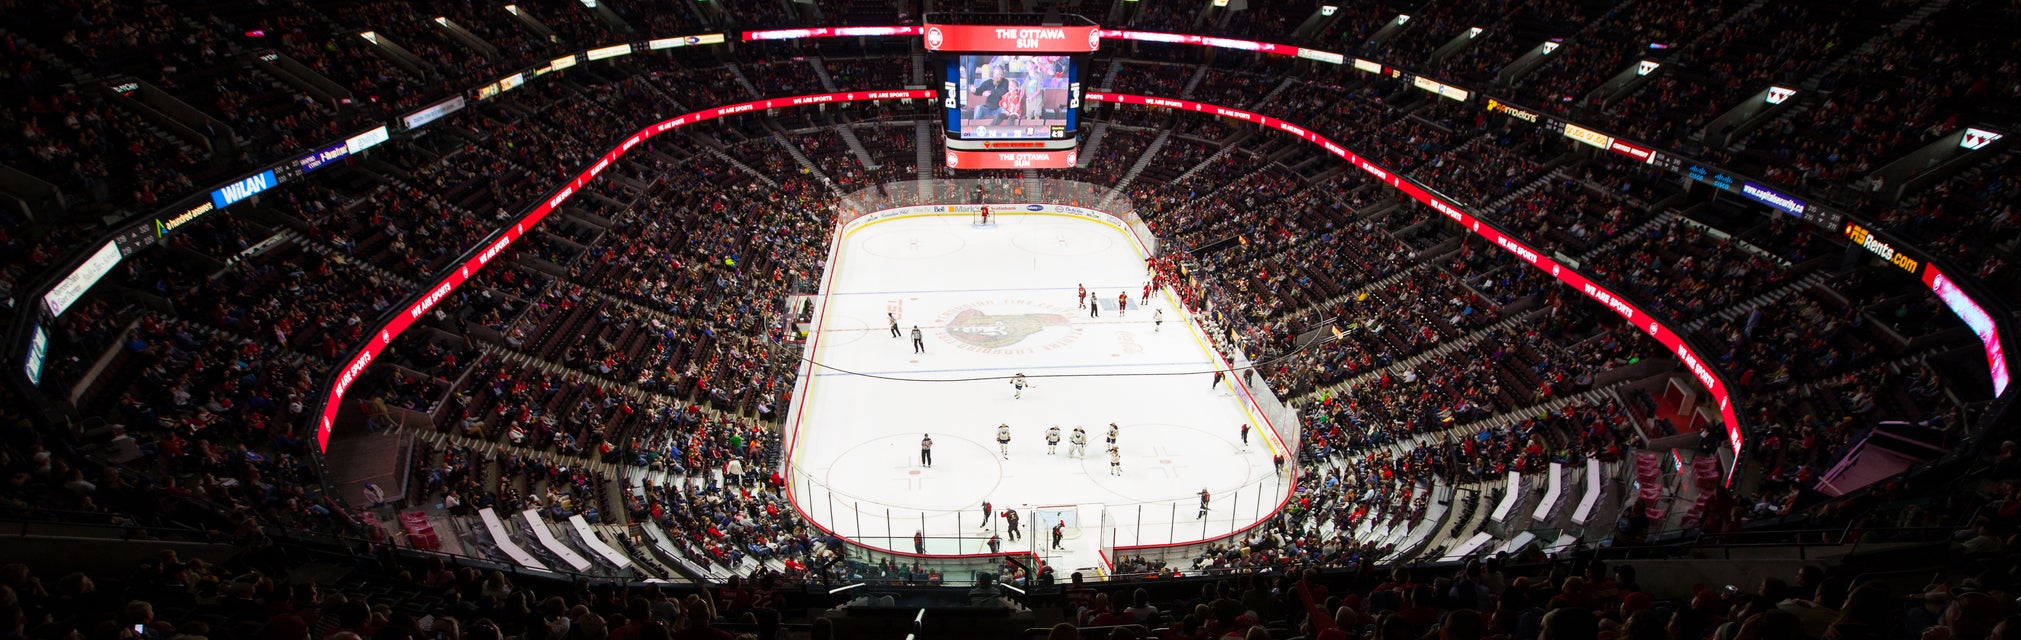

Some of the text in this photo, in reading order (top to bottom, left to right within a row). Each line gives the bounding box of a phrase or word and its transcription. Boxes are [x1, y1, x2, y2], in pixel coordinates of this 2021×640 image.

[995, 29, 1066, 40] THE OTTAWA
[1016, 39, 1039, 49] SUN
[944, 81, 957, 109] Bell
[1070, 82, 1080, 109] Bell
[1164, 100, 1182, 108] SPORTS
[725, 106, 735, 114] ARE
[735, 104, 753, 112] SPORTS
[220, 173, 267, 205] WiLAN
[1689, 171, 1703, 181] CISCO
[1713, 180, 1729, 190] CISCO
[1431, 199, 1438, 208] WE
[1446, 207, 1462, 221] SPORTS
[479, 253, 488, 264] WE
[494, 236, 510, 253] SPORTS
[1498, 235, 1537, 263] WE ARE SPORTS
[411, 281, 451, 318] WE ARE SPORTS
[1585, 283, 1633, 318] WE ARE SPORTS
[336, 350, 371, 398] WE ARE SPORTS
[1678, 344, 1714, 389] WE ARE SPORTS
[752, 593, 774, 609] 22
